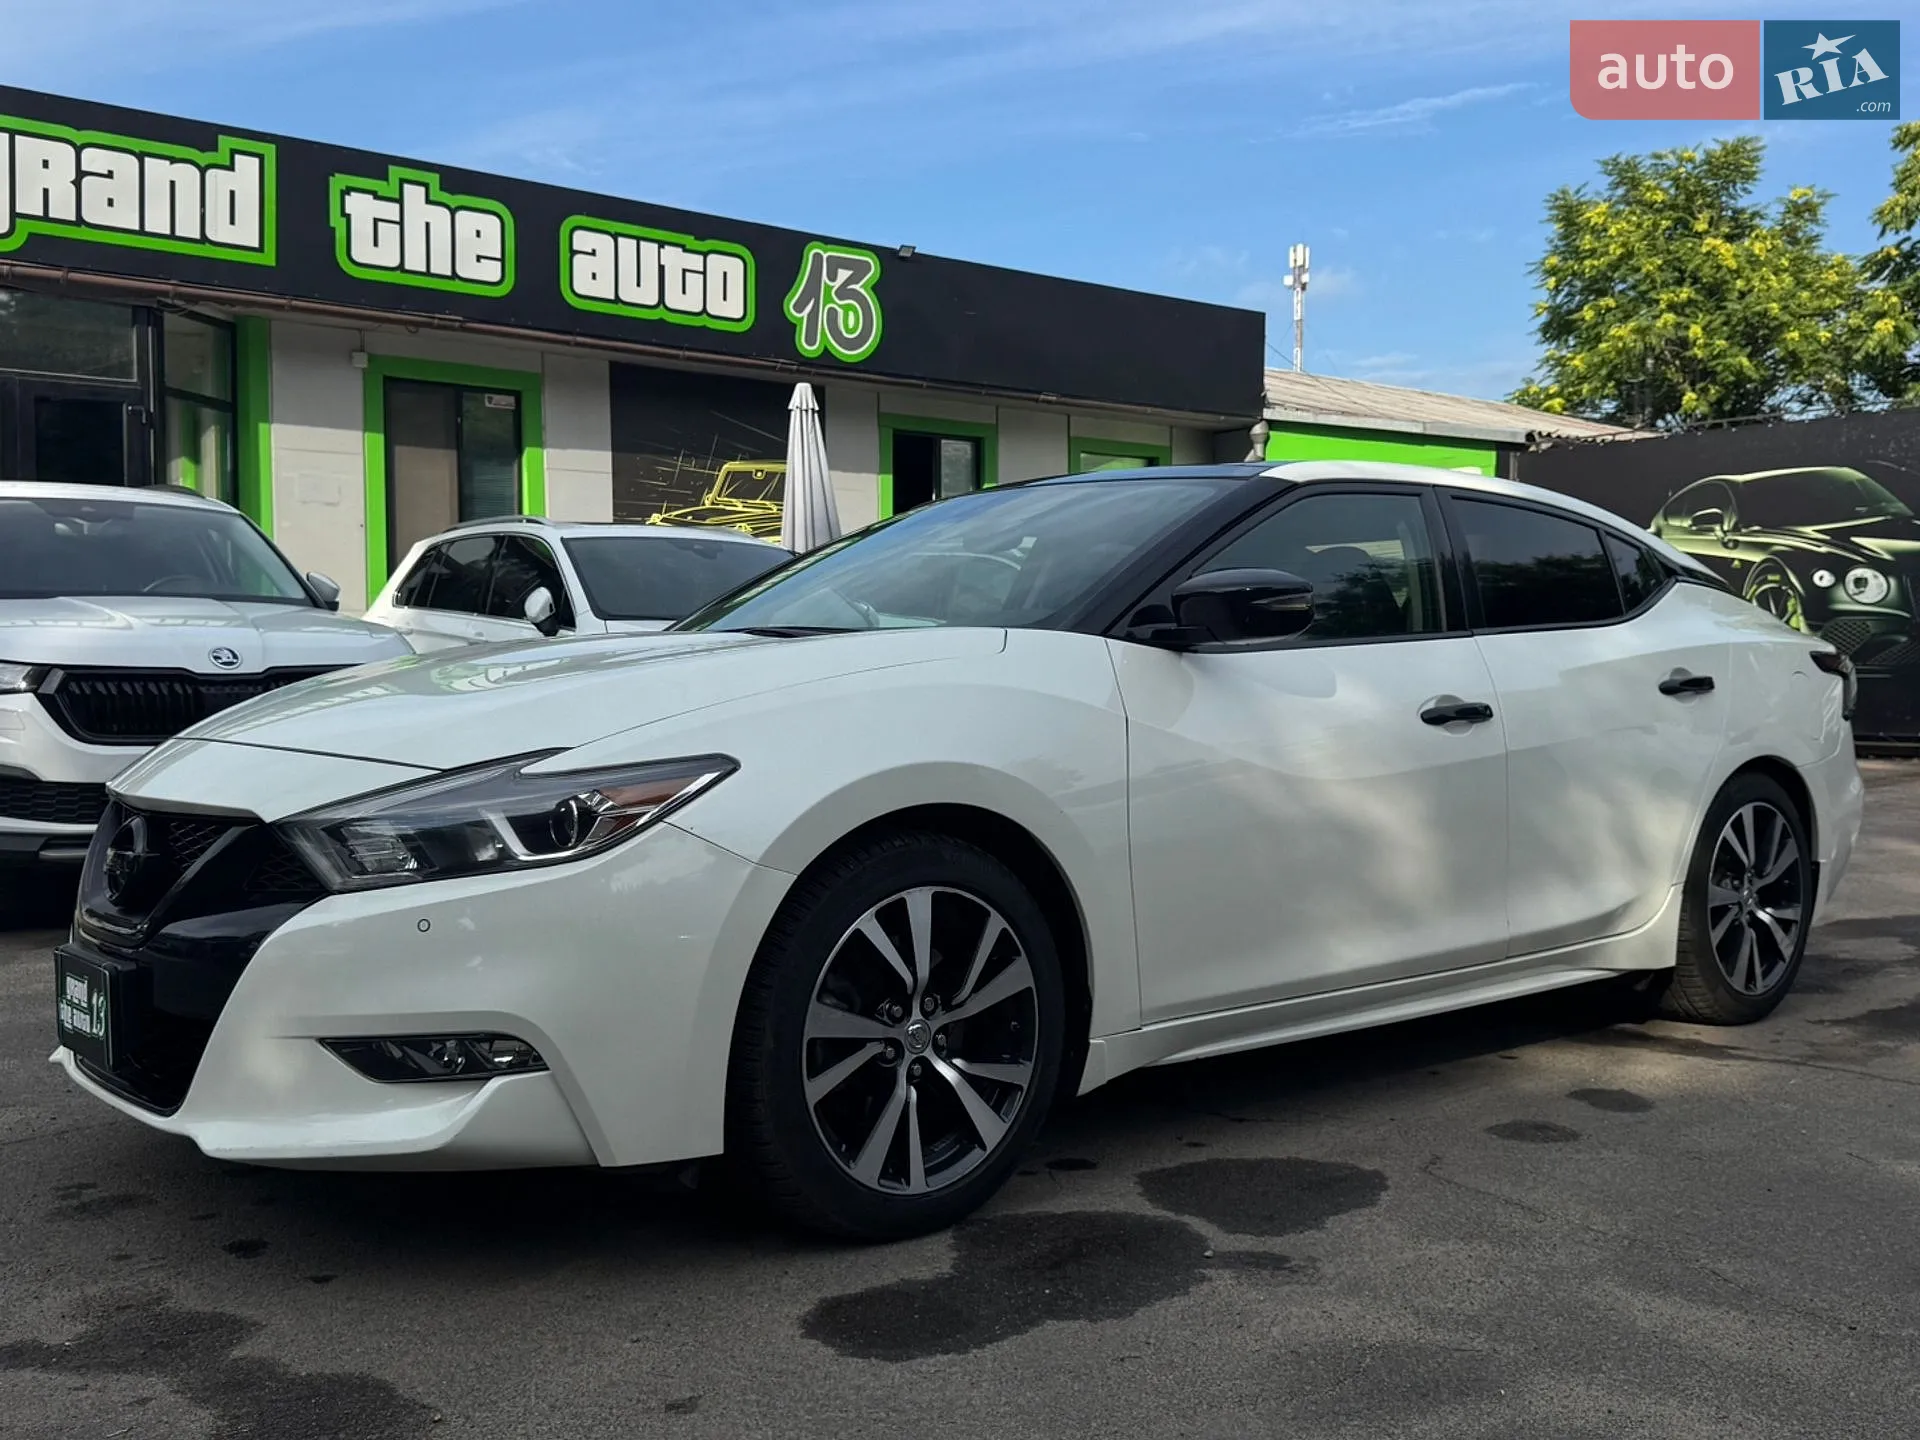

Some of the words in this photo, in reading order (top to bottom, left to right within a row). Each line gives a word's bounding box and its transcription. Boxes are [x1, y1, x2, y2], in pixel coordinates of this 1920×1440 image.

[345, 184, 501, 282] the
[572, 230, 744, 319] auto
[790, 249, 877, 355] 13
